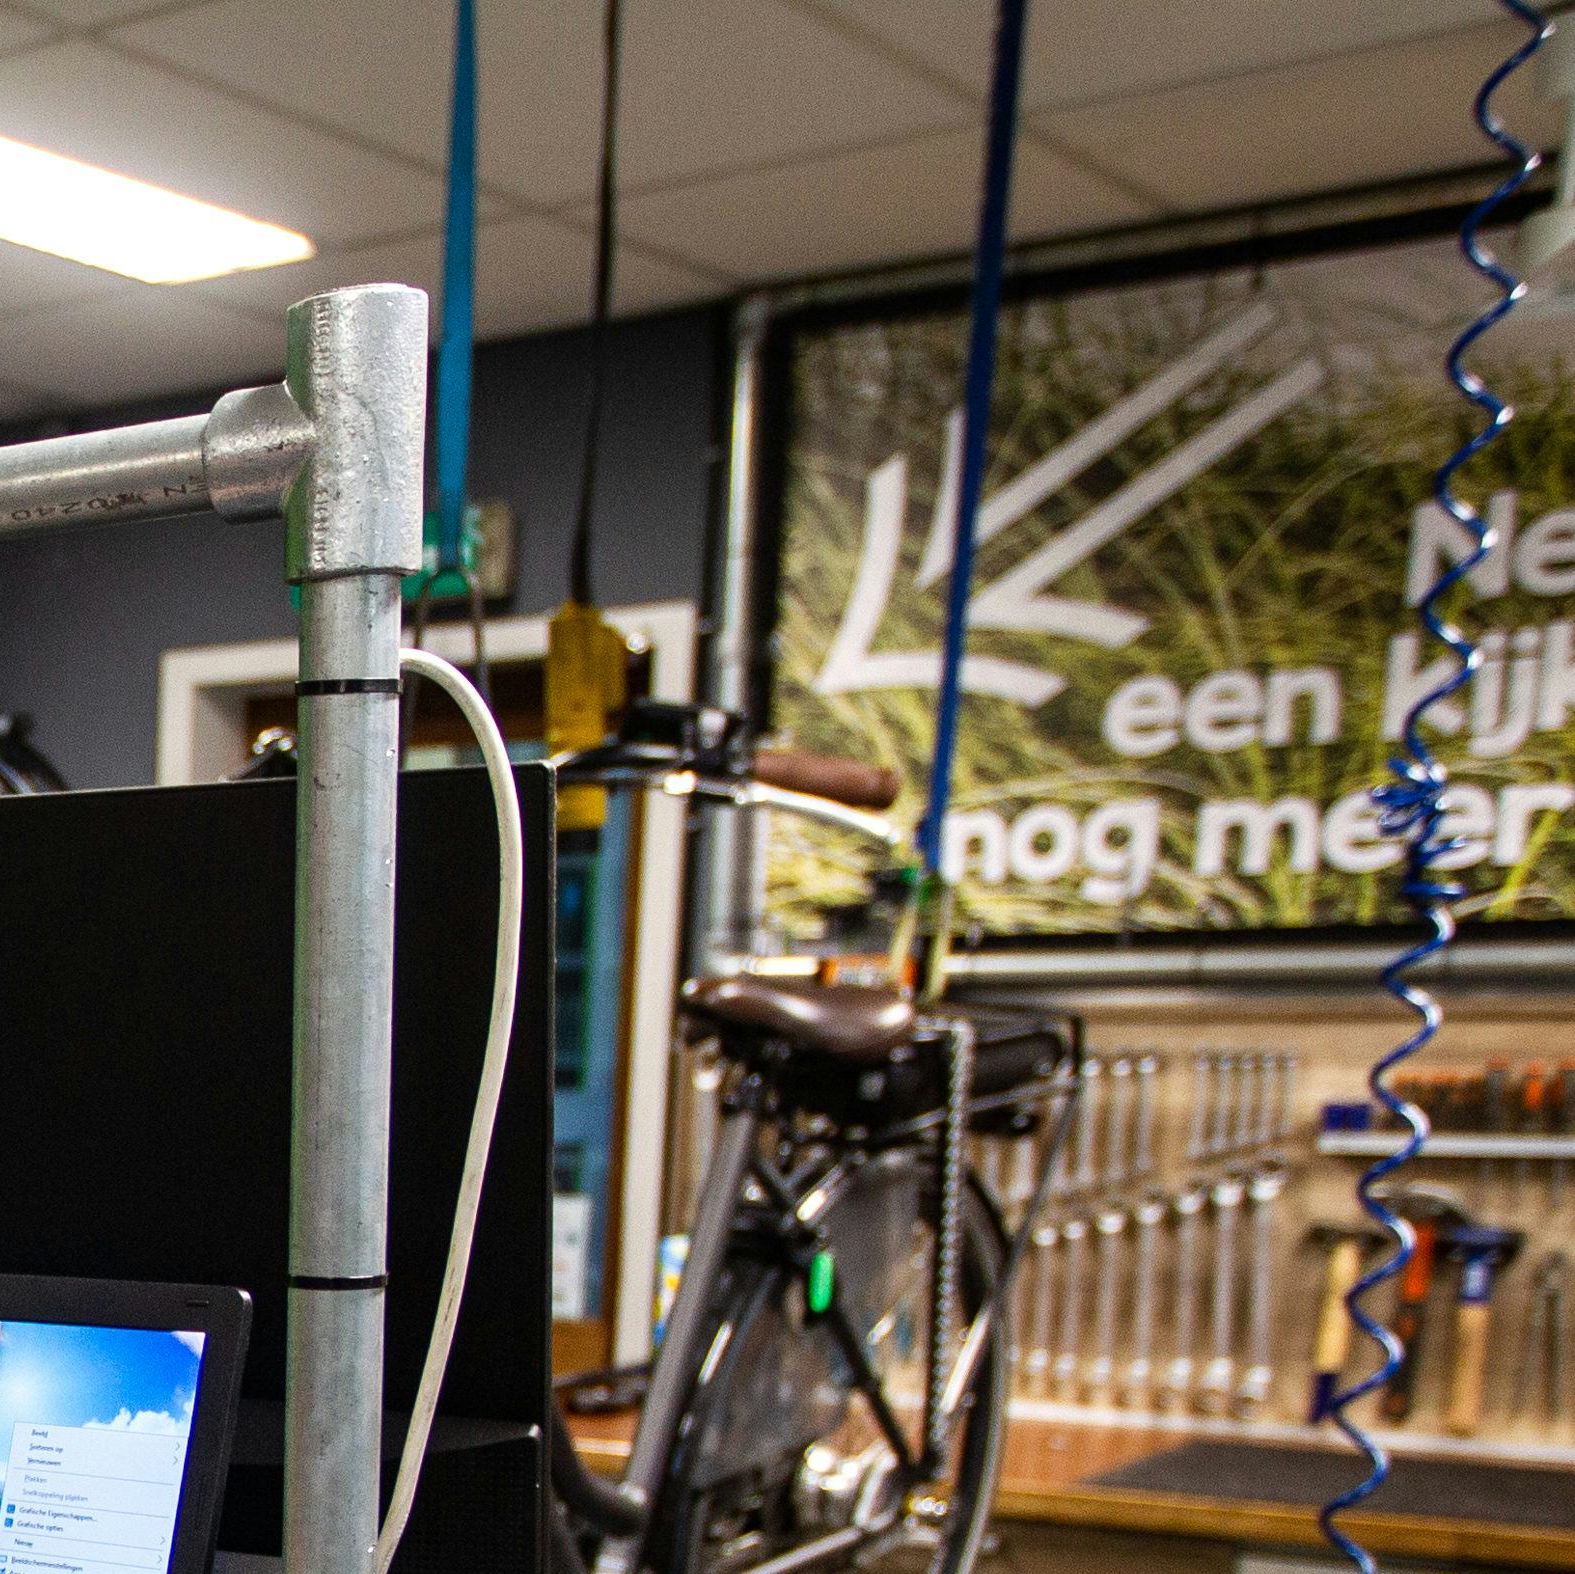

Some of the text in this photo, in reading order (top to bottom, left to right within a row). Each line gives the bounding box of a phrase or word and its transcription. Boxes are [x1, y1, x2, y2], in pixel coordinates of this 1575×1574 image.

[1103, 664, 1343, 758] een
[940, 781, 1575, 903] nog meer
